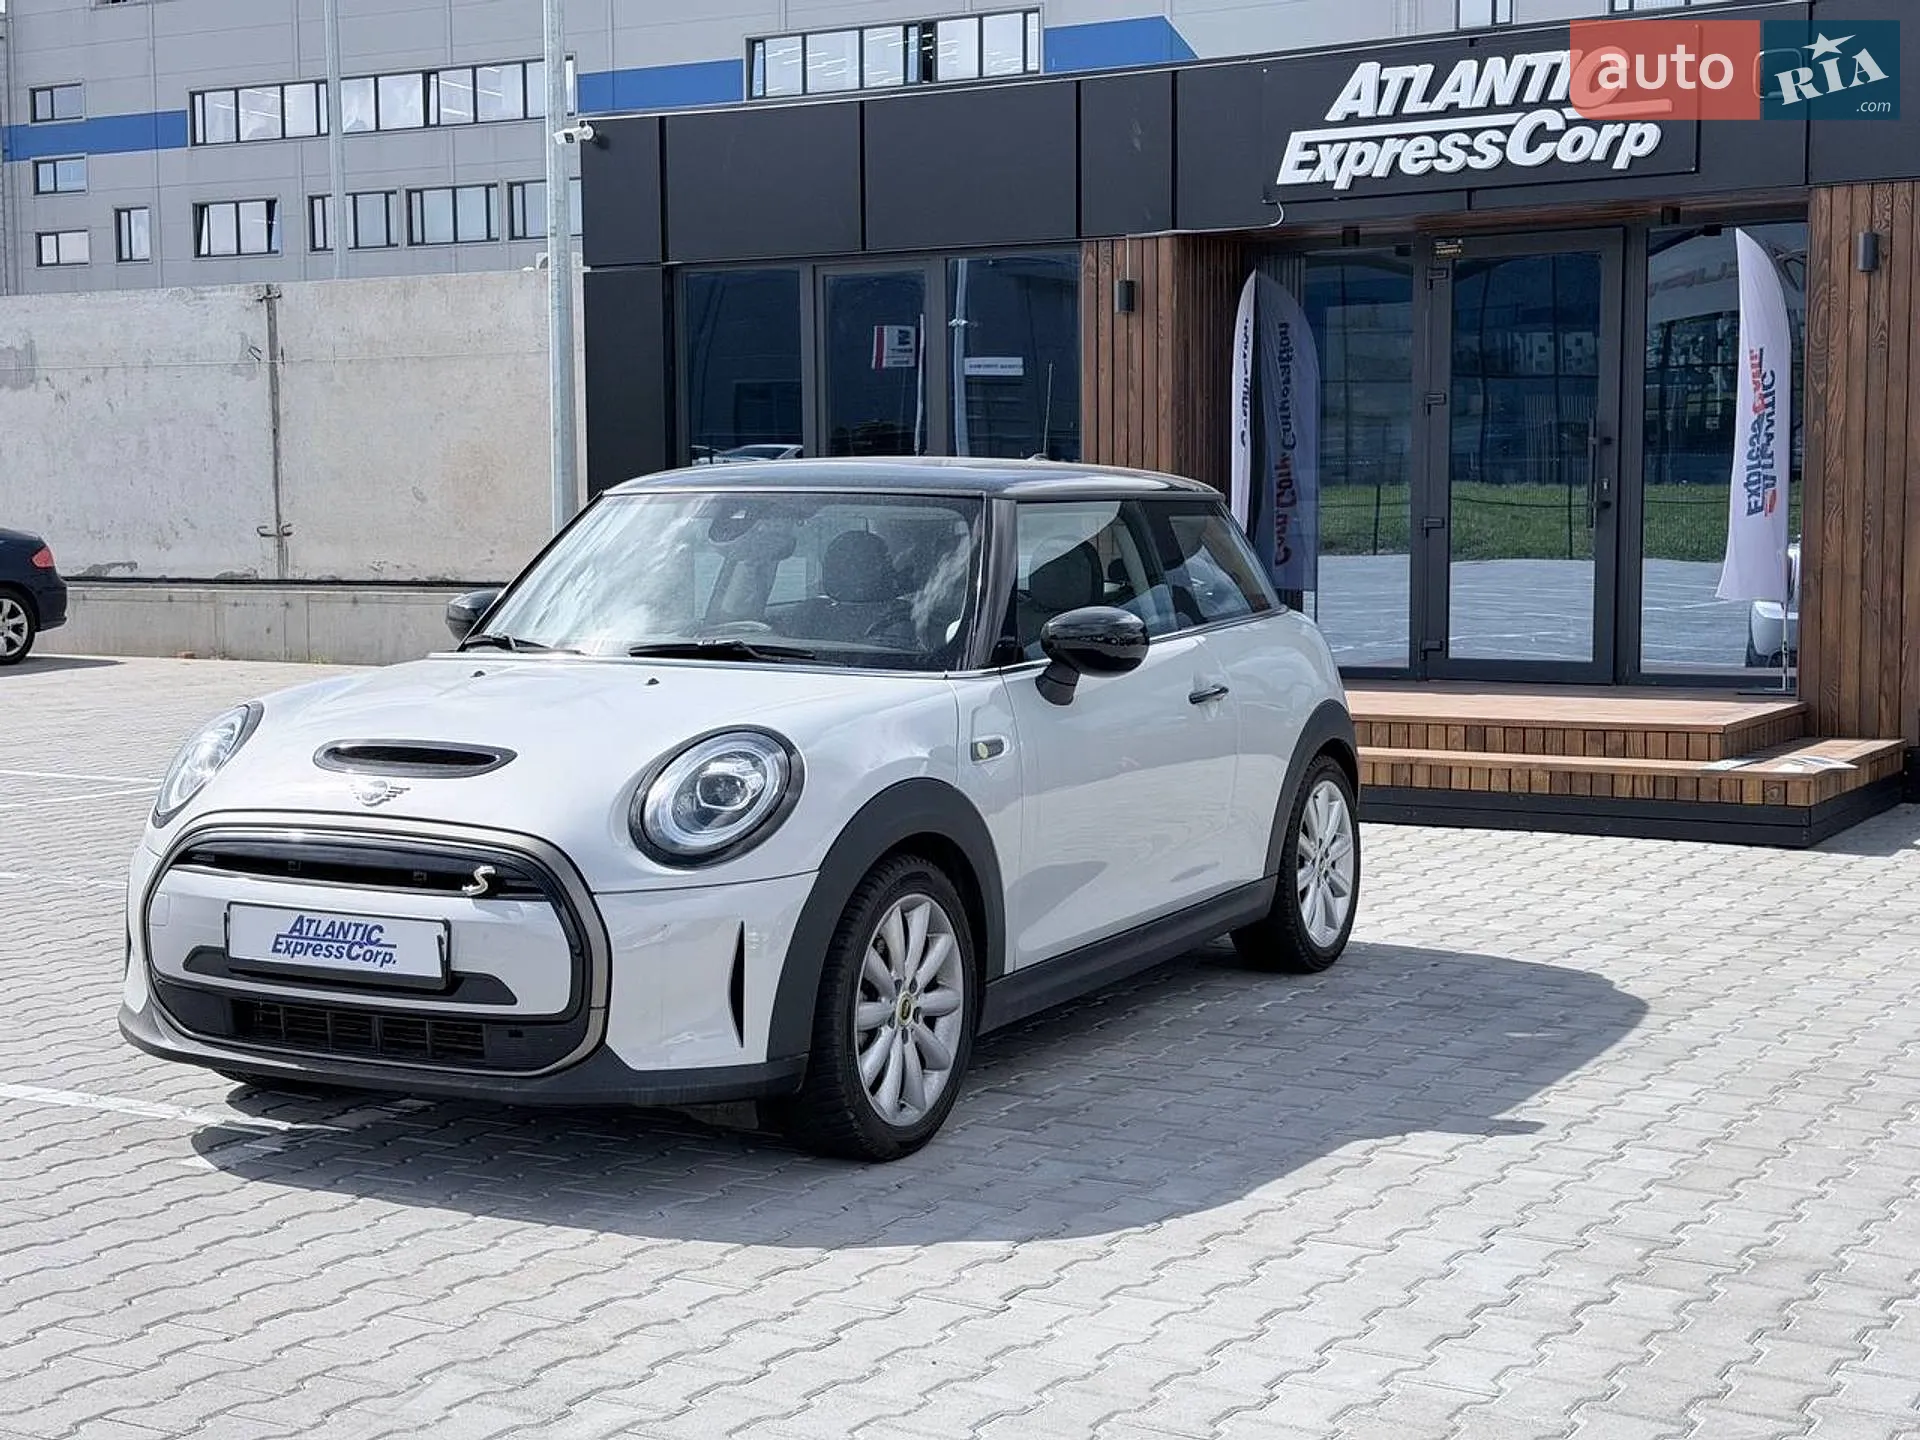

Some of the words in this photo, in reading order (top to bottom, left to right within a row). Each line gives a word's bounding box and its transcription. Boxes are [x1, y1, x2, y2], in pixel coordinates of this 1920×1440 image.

[1325, 45, 1631, 121] ATLANTIC
[289, 914, 385, 946] ATLANTIC
[271, 937, 397, 967] ExpressCorp.
